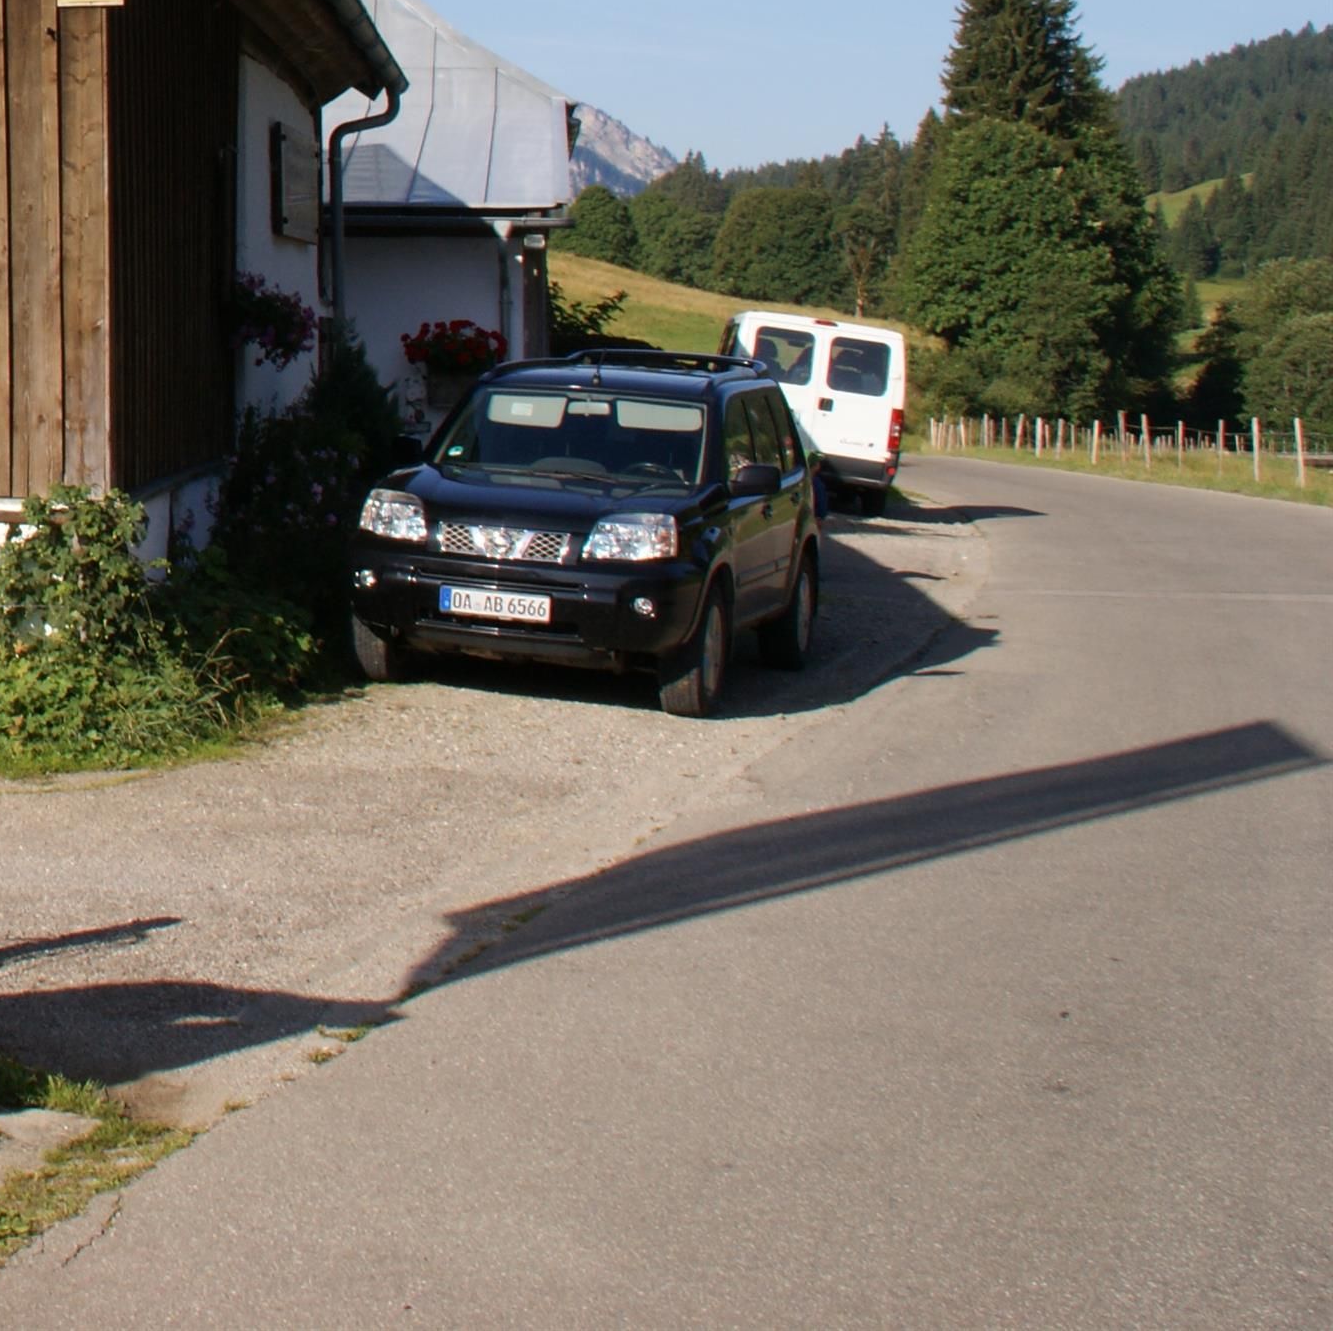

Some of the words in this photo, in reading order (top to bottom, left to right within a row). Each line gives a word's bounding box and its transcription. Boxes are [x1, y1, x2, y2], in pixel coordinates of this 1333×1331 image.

[453, 591, 472, 609] OA
[484, 596, 503, 613] AB
[507, 598, 547, 617] 6566
